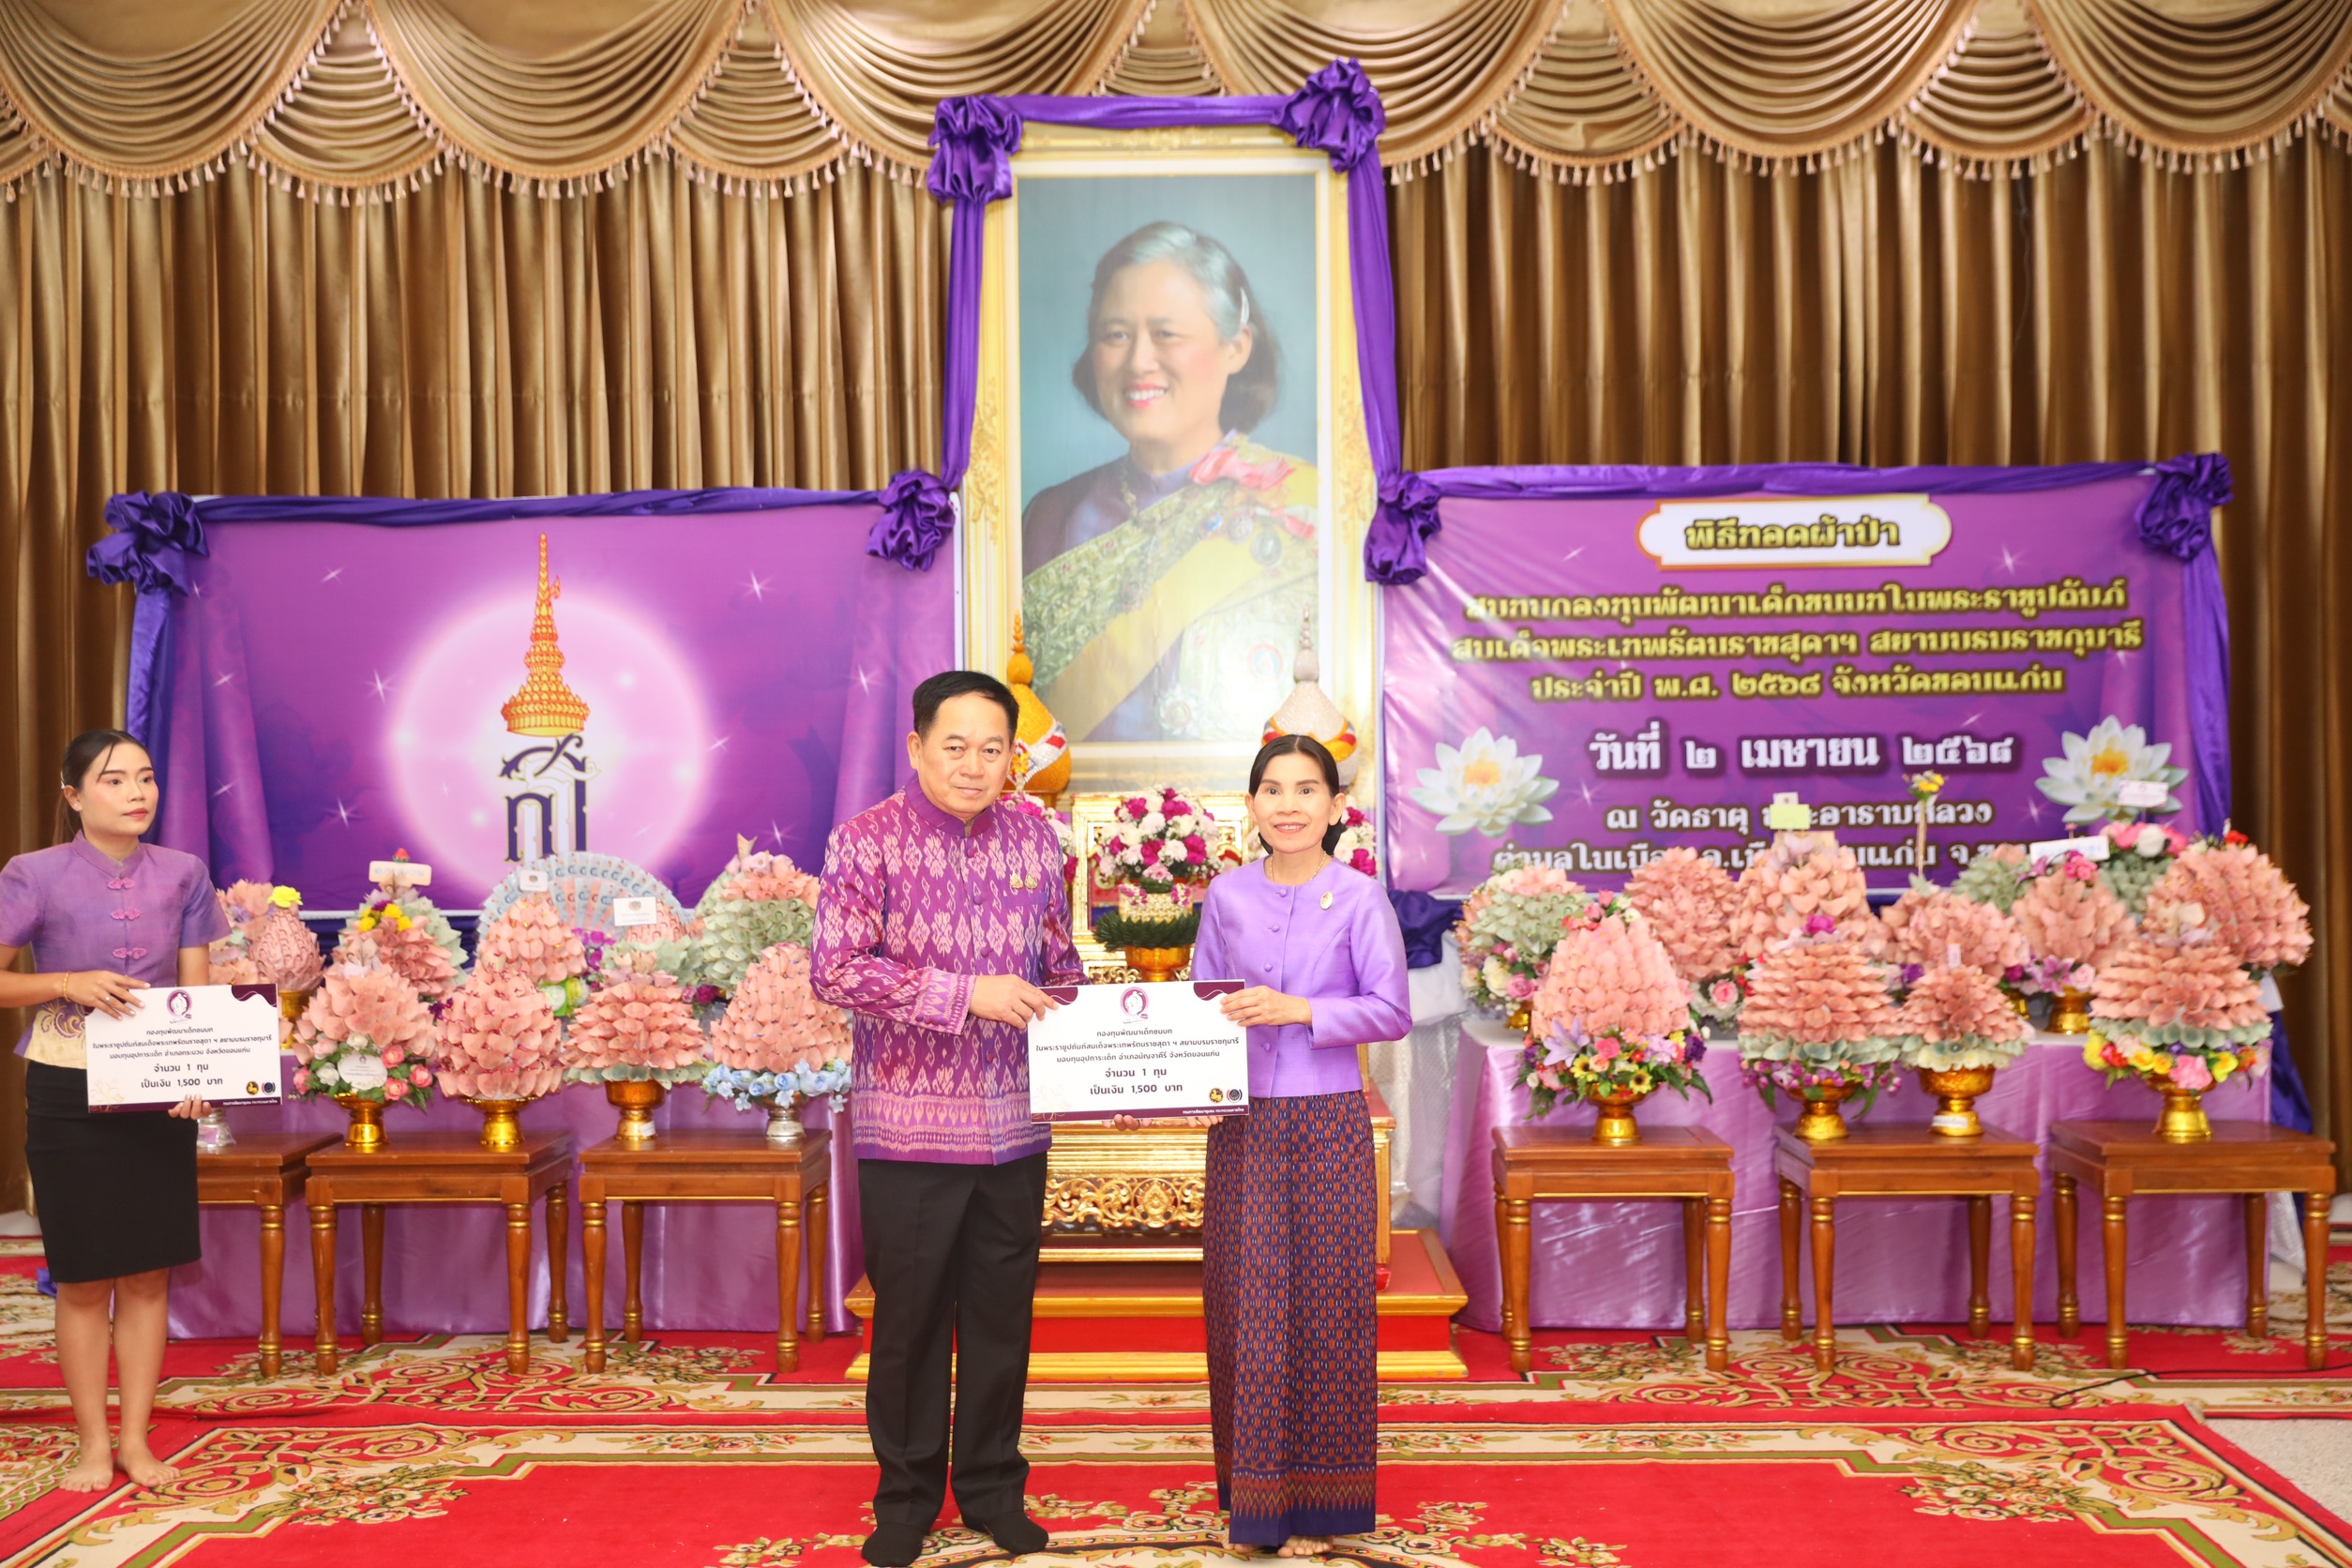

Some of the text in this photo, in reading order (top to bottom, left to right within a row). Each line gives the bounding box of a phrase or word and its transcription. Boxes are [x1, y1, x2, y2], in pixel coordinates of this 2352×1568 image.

[1685, 515, 1900, 549] พิธีทอดผ้าป่า
[1869, 620, 2142, 657] สยามบรมราชกุมารี
[1531, 670, 1642, 700] ประจำปี
[1654, 674, 1718, 699] พ.ศ.
[1832, 663, 2063, 694] จังหวัดขอนแก่น
[1589, 721, 1661, 770] วันที่
[1685, 740, 1717, 769] ๒
[1741, 737, 1880, 768] เมษายน
[1606, 808, 1637, 828] ณ
[1651, 800, 1749, 834] วัดธาตุ
[141, 1078, 223, 1089] เป็นเงิน 1,500 บาท
[154, 1063, 181, 1073] จำนวน
[197, 1063, 209, 1073] ทุน
[1105, 1067, 1168, 1079] จำนวน 1 ทุน
[1090, 1083, 1184, 1095] เป็นเงิน 1,500 บาท
